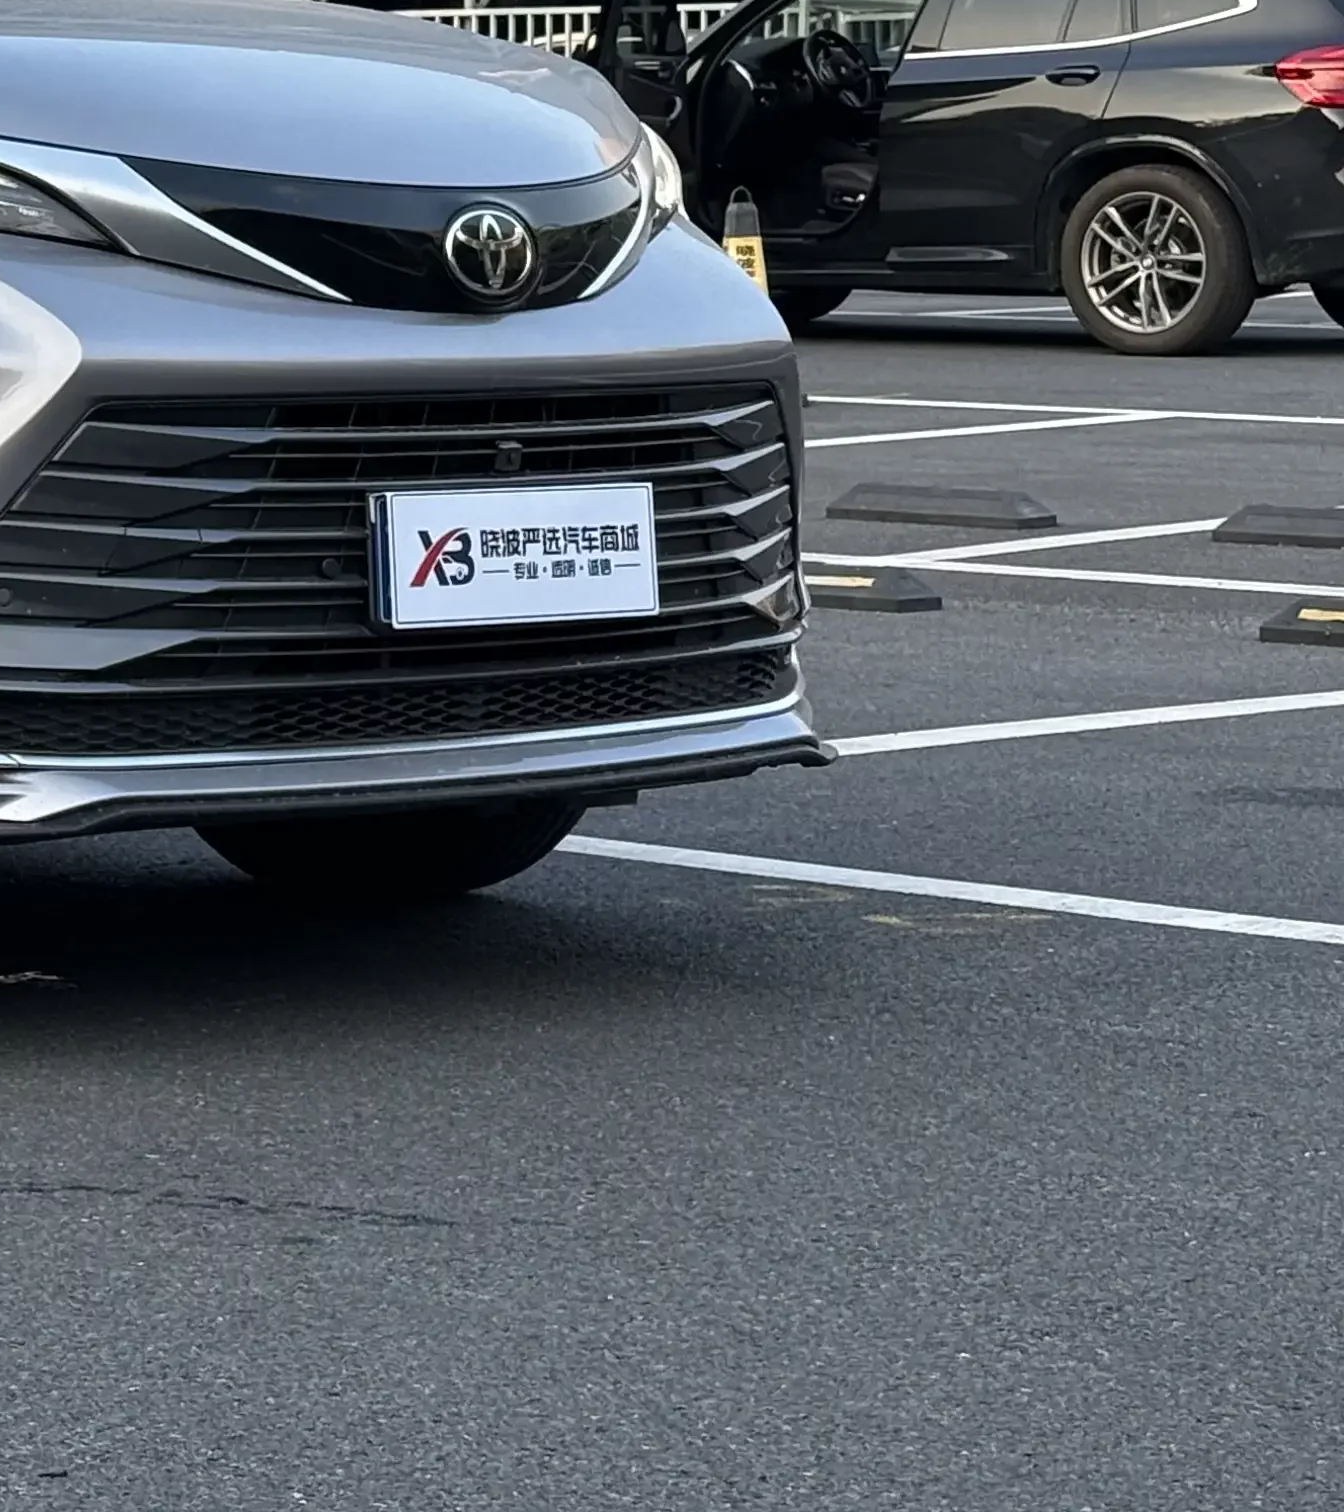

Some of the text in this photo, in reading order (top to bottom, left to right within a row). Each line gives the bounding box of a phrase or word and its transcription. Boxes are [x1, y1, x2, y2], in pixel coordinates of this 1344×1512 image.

[479, 523, 641, 558] 晓波严选汽车商城
